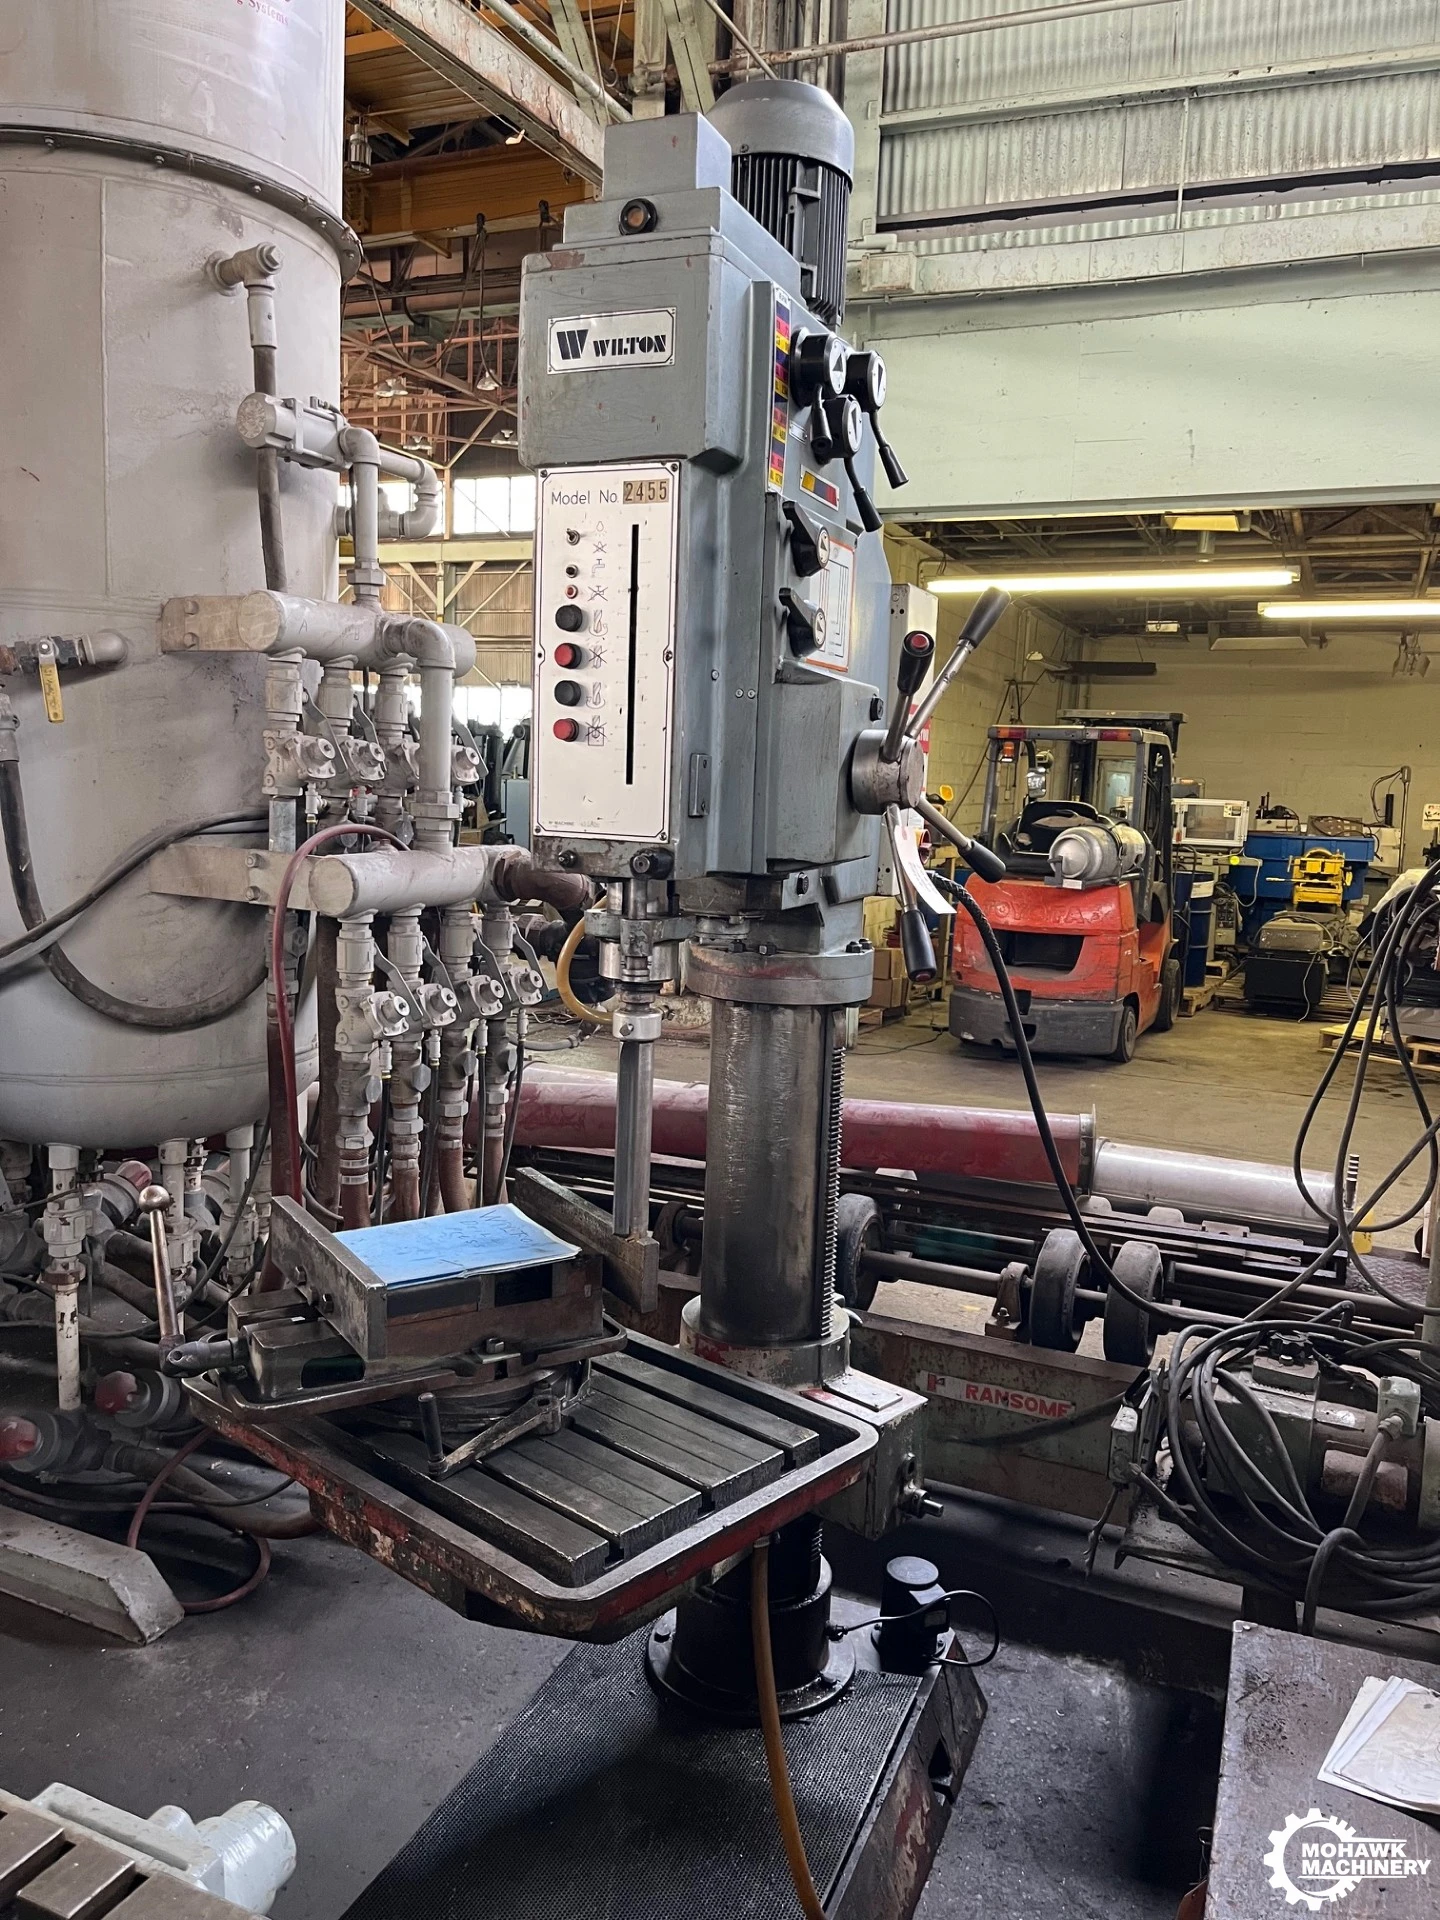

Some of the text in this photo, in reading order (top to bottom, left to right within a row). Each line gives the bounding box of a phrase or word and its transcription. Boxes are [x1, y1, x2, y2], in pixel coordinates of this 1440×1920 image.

[593, 334, 666, 357] WILTON
[551, 490, 591, 505] Model
[625, 481, 667, 502] 2455
[966, 1384, 1072, 1418] RANSOME
